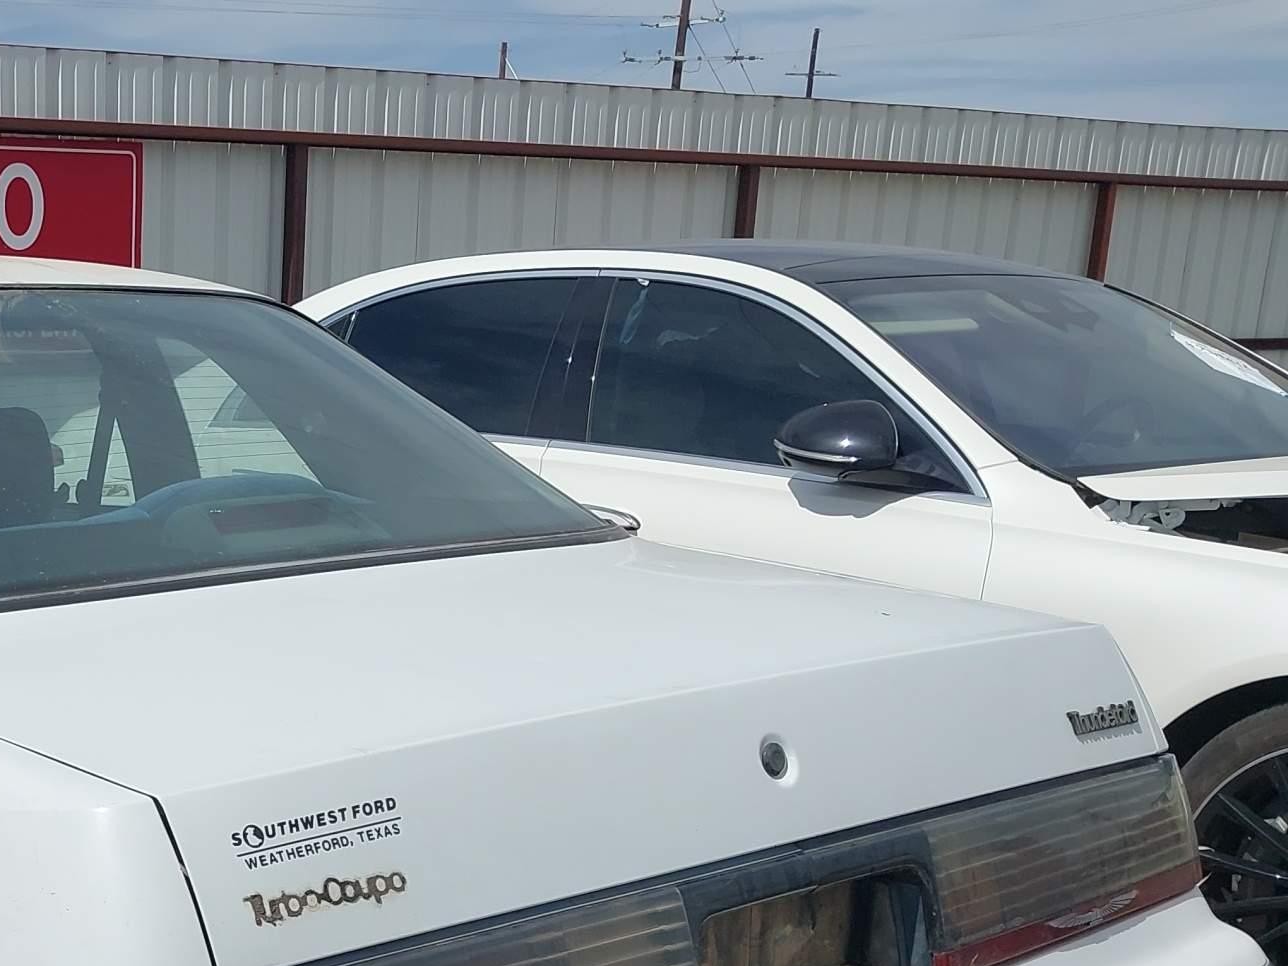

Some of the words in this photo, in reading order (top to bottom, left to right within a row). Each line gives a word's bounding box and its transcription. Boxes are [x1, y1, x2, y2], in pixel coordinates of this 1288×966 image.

[351, 797, 397, 820] FORD
[245, 835, 354, 870] WEATHERFORD,
[357, 823, 401, 843] TEXAS
